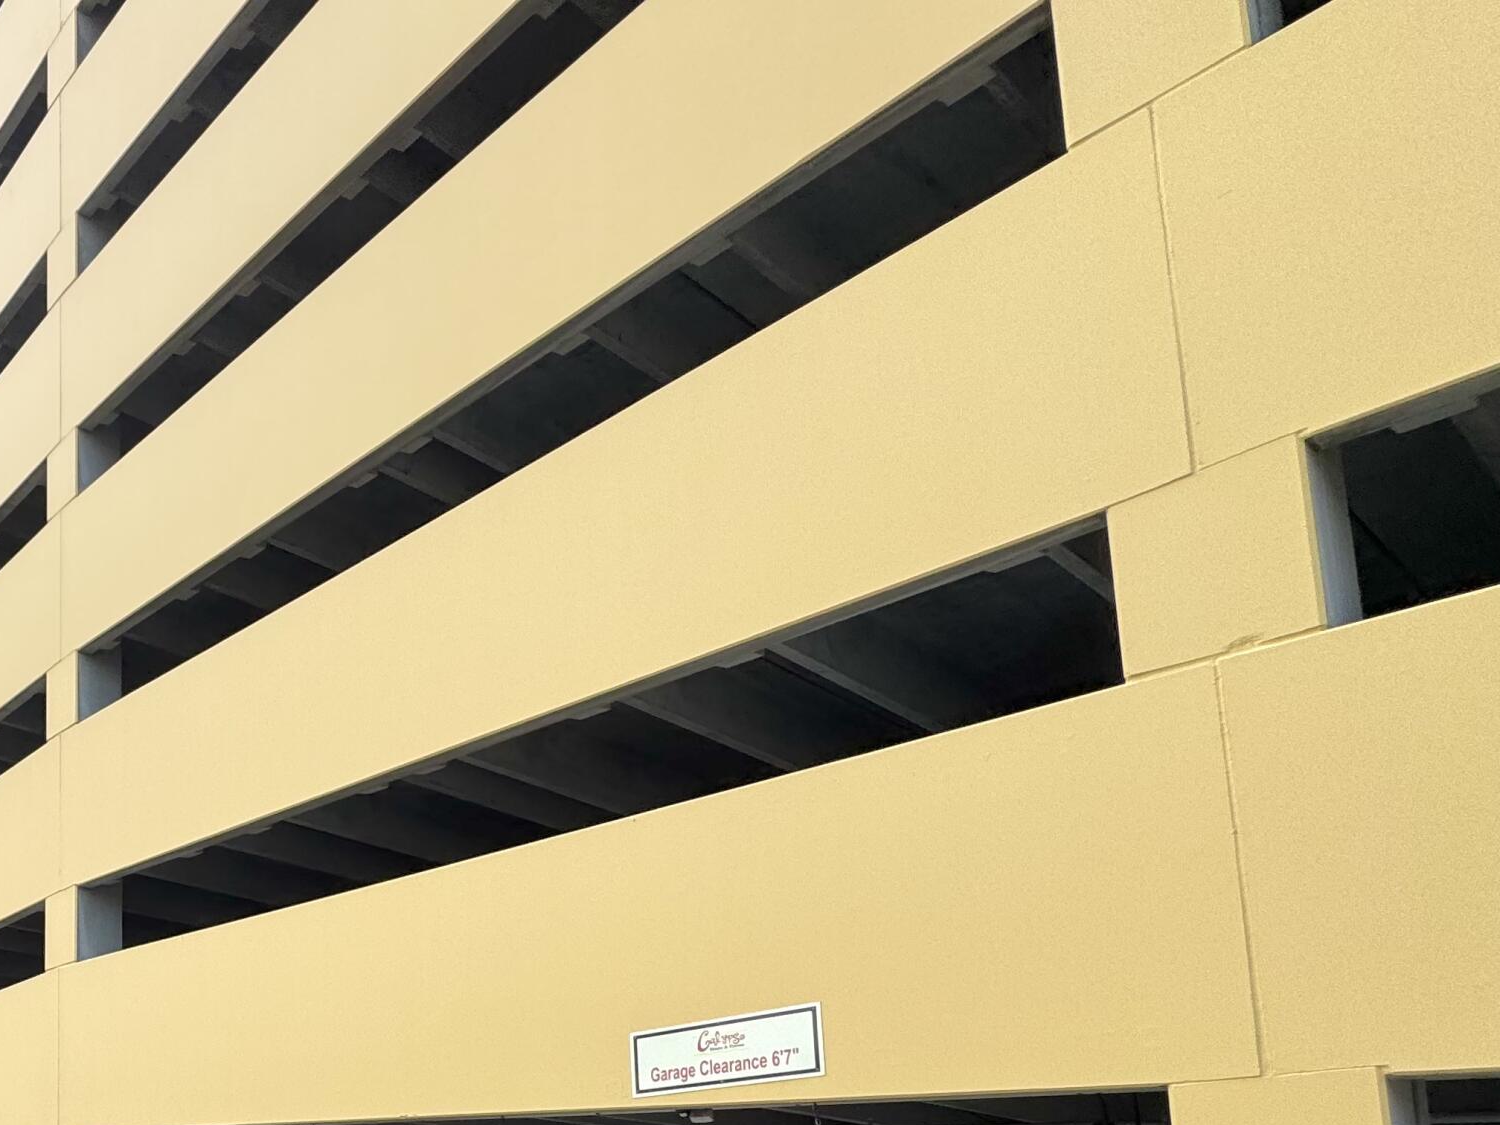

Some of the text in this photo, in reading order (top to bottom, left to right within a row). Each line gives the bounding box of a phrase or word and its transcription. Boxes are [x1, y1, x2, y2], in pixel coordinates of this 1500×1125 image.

[698, 1030, 745, 1052] Calypso
[651, 1048, 799, 1082] Garage Clearance 6'7"
